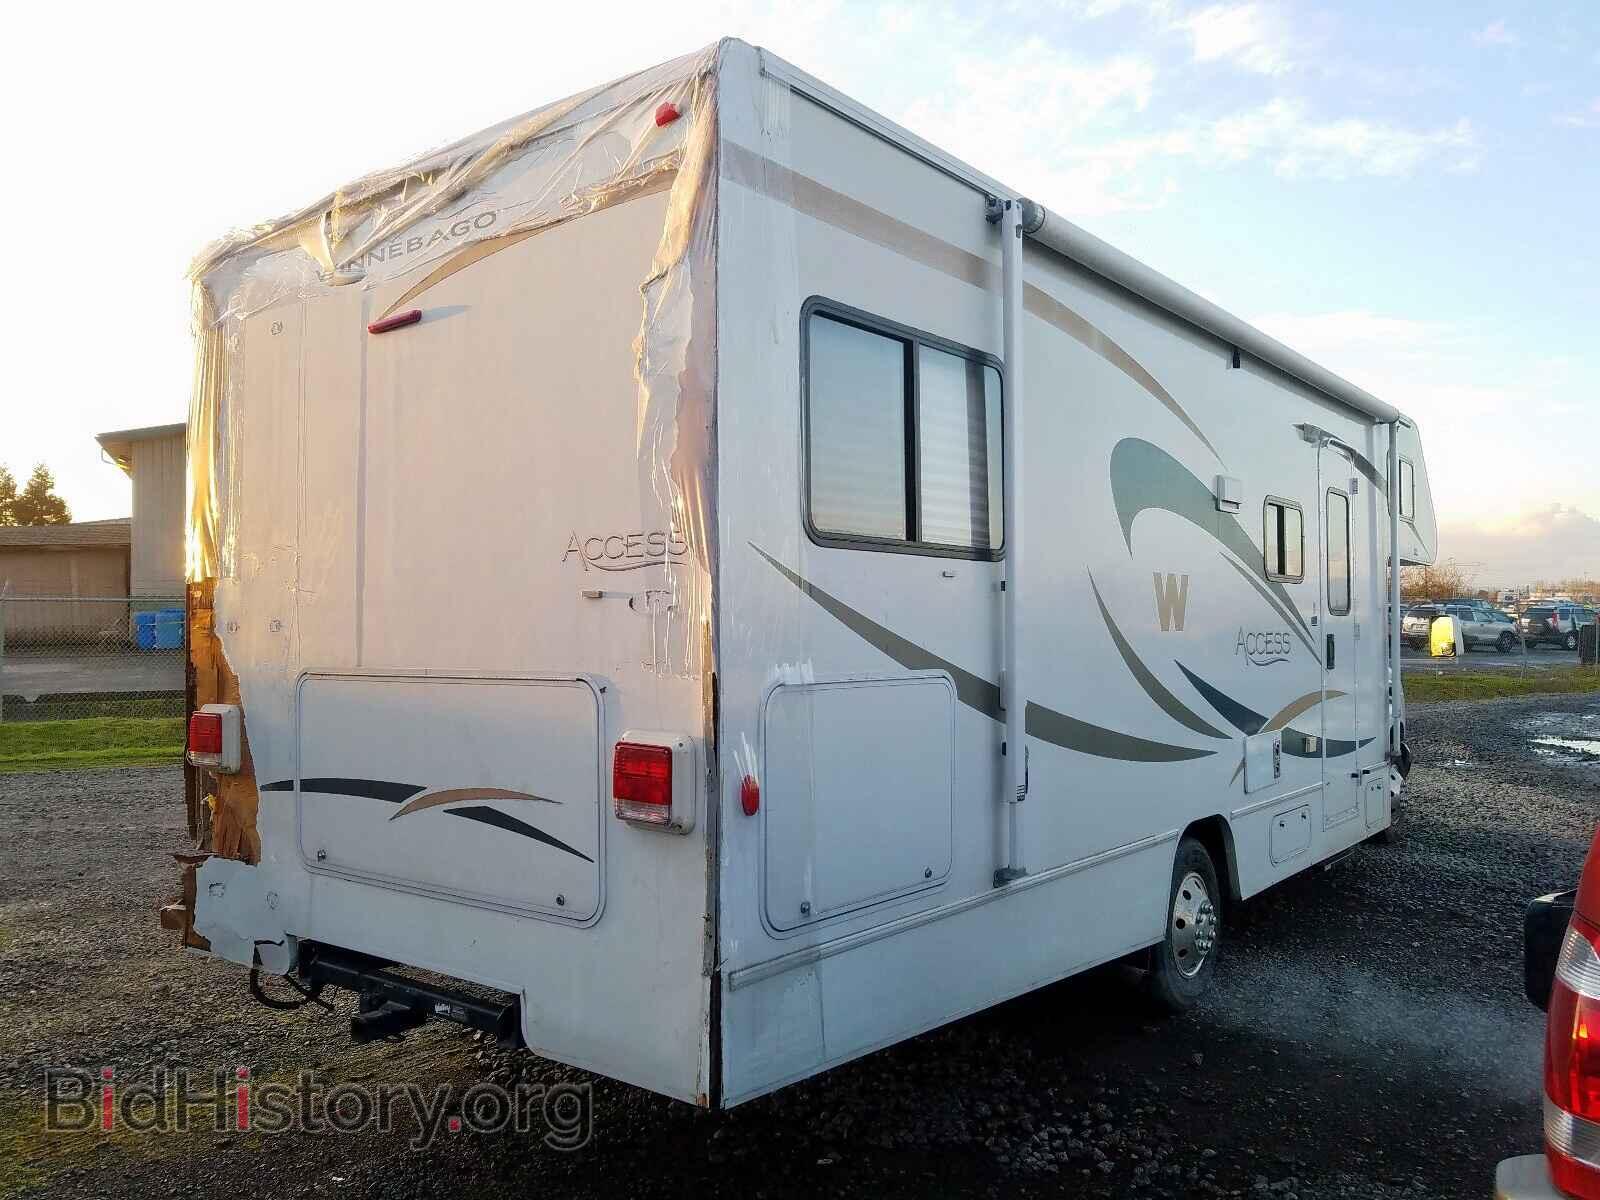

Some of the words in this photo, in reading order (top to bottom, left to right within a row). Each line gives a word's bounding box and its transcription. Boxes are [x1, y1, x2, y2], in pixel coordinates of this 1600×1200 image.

[561, 530, 689, 572] ACCESS
[1152, 571, 1190, 632] W
[1235, 626, 1292, 667] ACCESS
